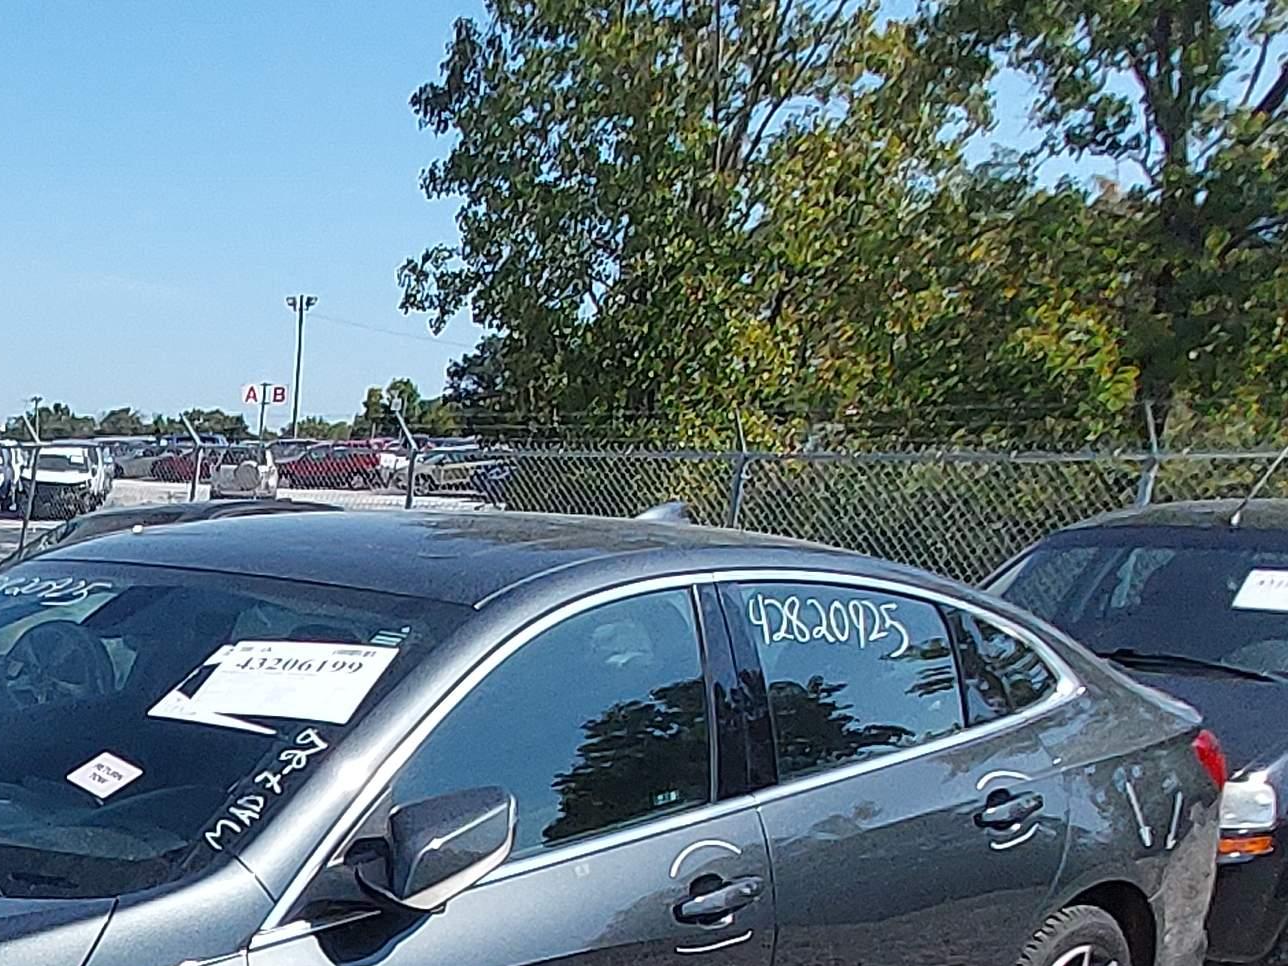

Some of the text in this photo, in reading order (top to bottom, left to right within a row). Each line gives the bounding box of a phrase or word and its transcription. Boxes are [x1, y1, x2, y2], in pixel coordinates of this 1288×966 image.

[244, 386, 286, 403] A B
[748, 594, 909, 658] 42820925
[236, 656, 364, 674] 43206199
[204, 794, 265, 850] MAD
